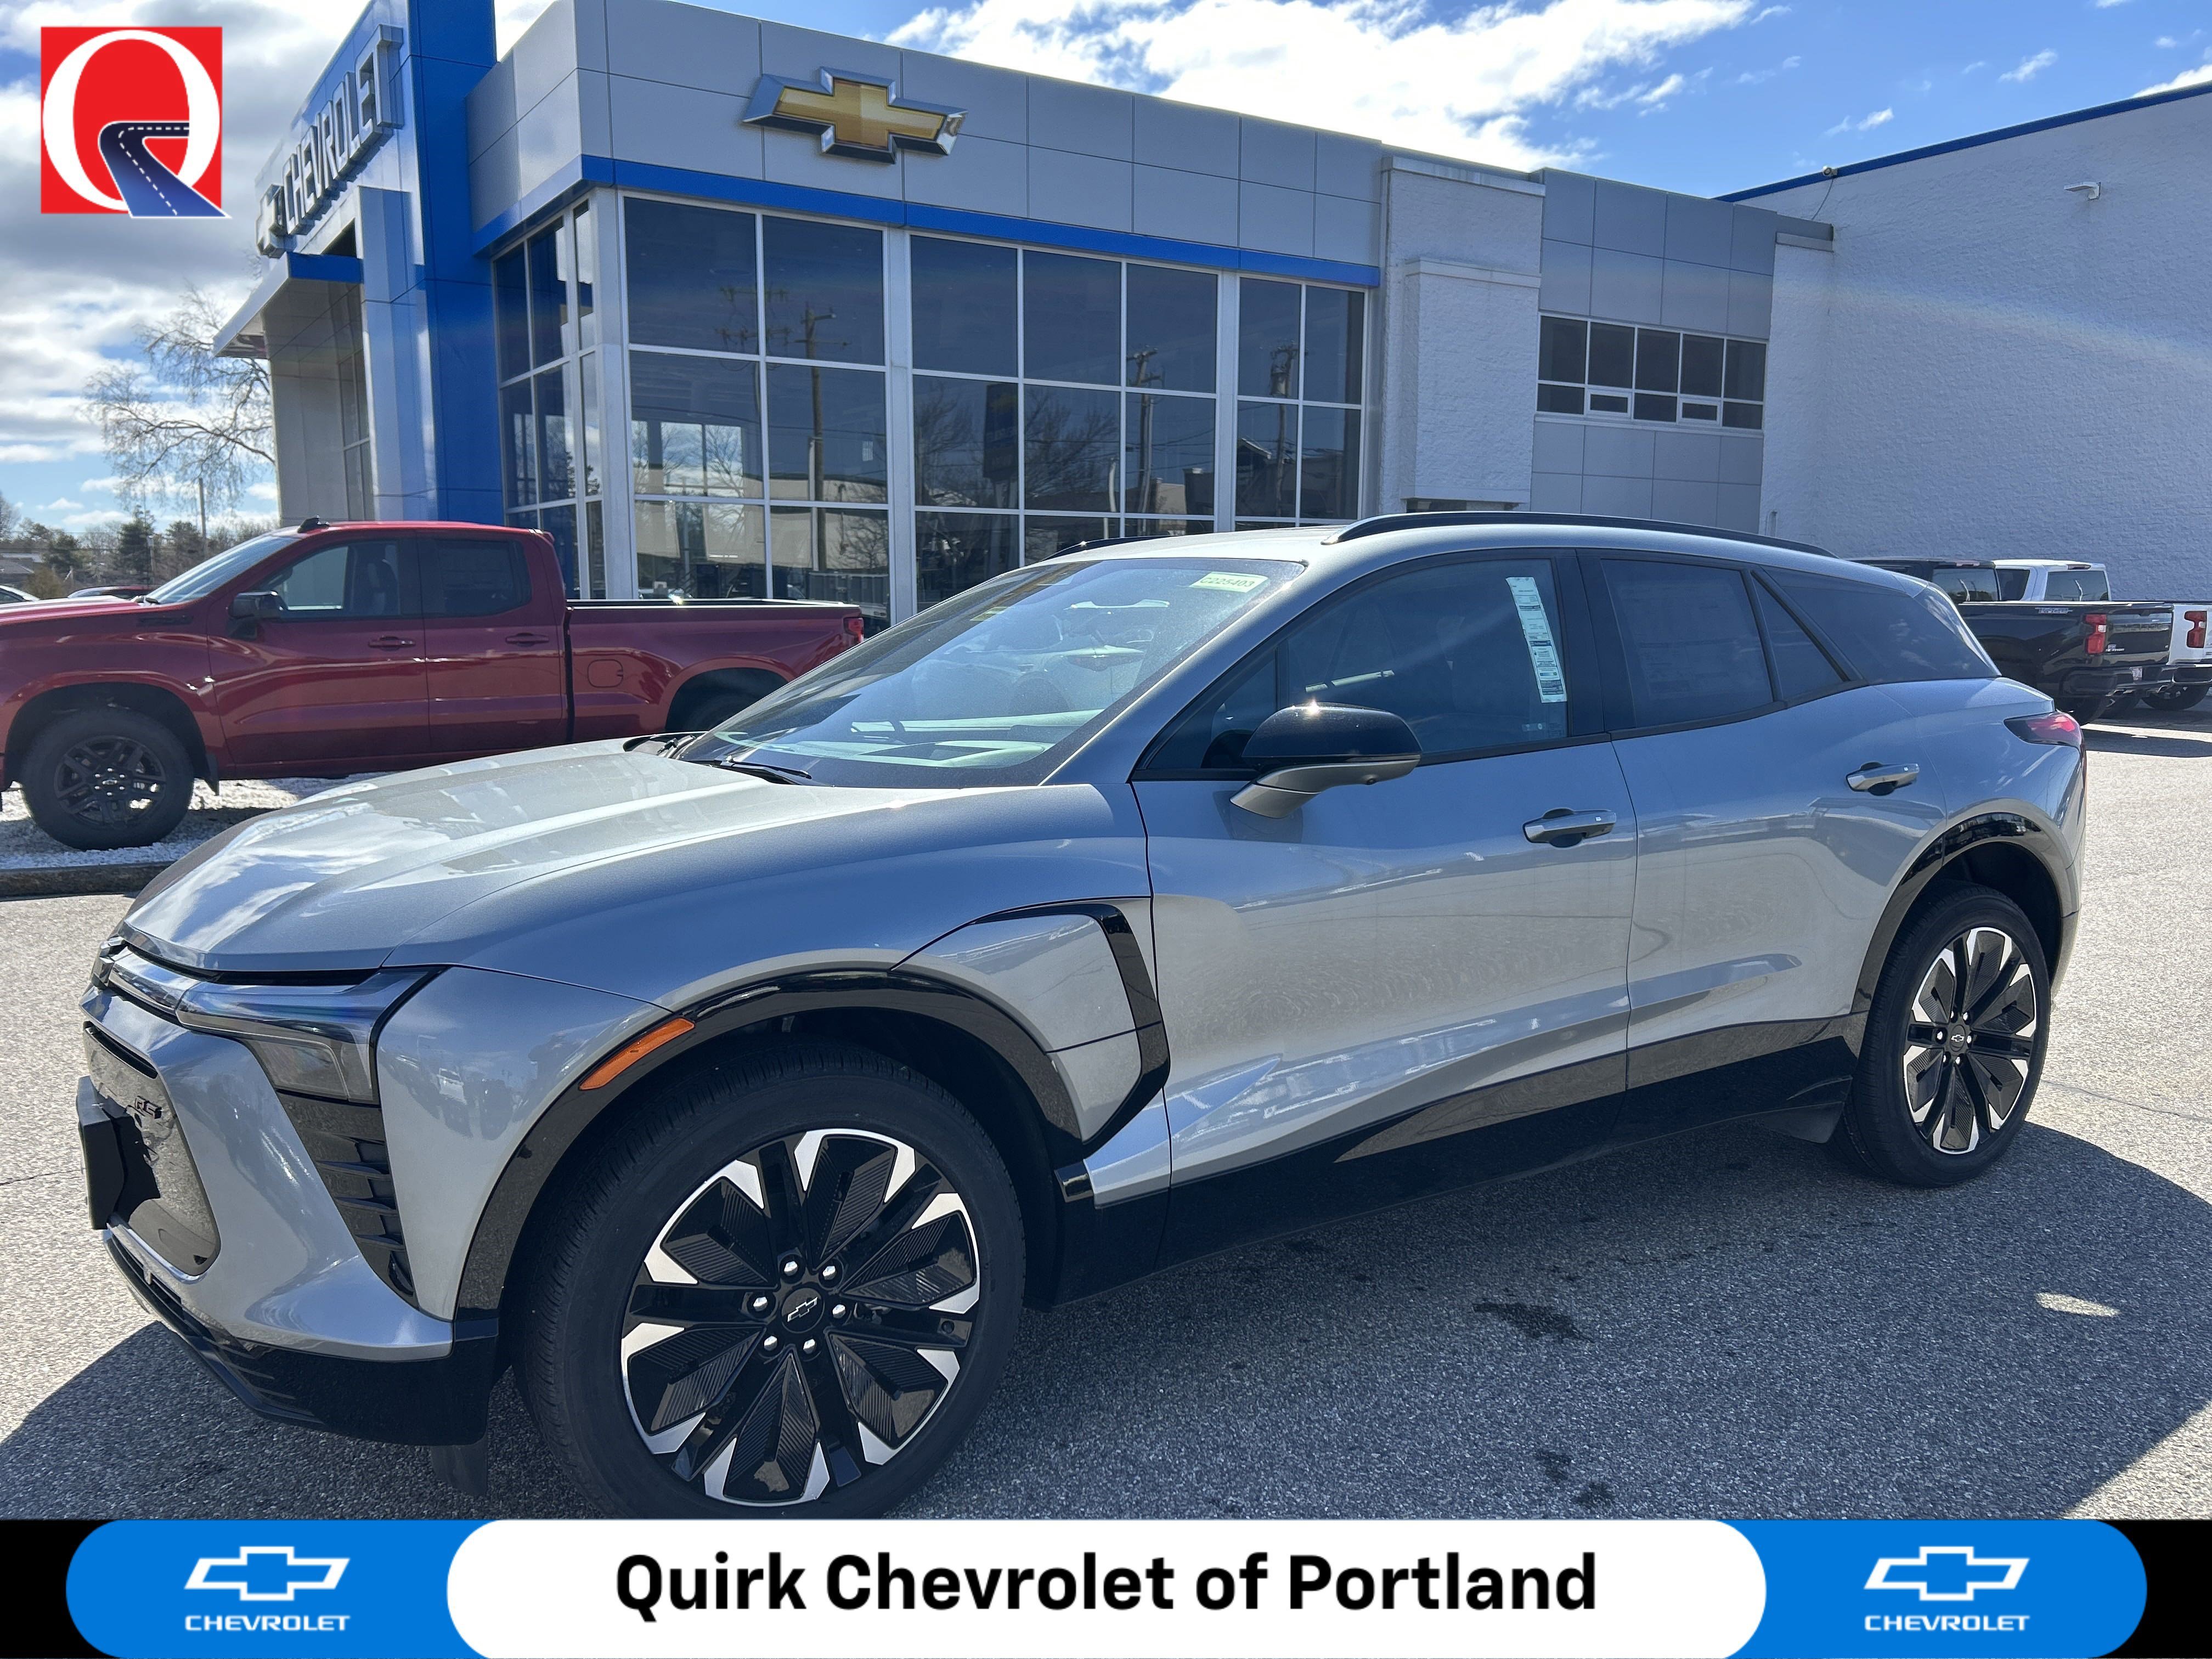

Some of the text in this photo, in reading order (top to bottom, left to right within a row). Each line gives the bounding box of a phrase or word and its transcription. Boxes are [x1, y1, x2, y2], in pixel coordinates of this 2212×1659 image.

[281, 24, 404, 235] CHEVROLET
[1200, 577, 1255, 588] C225403
[134, 1095, 162, 1119] RS
